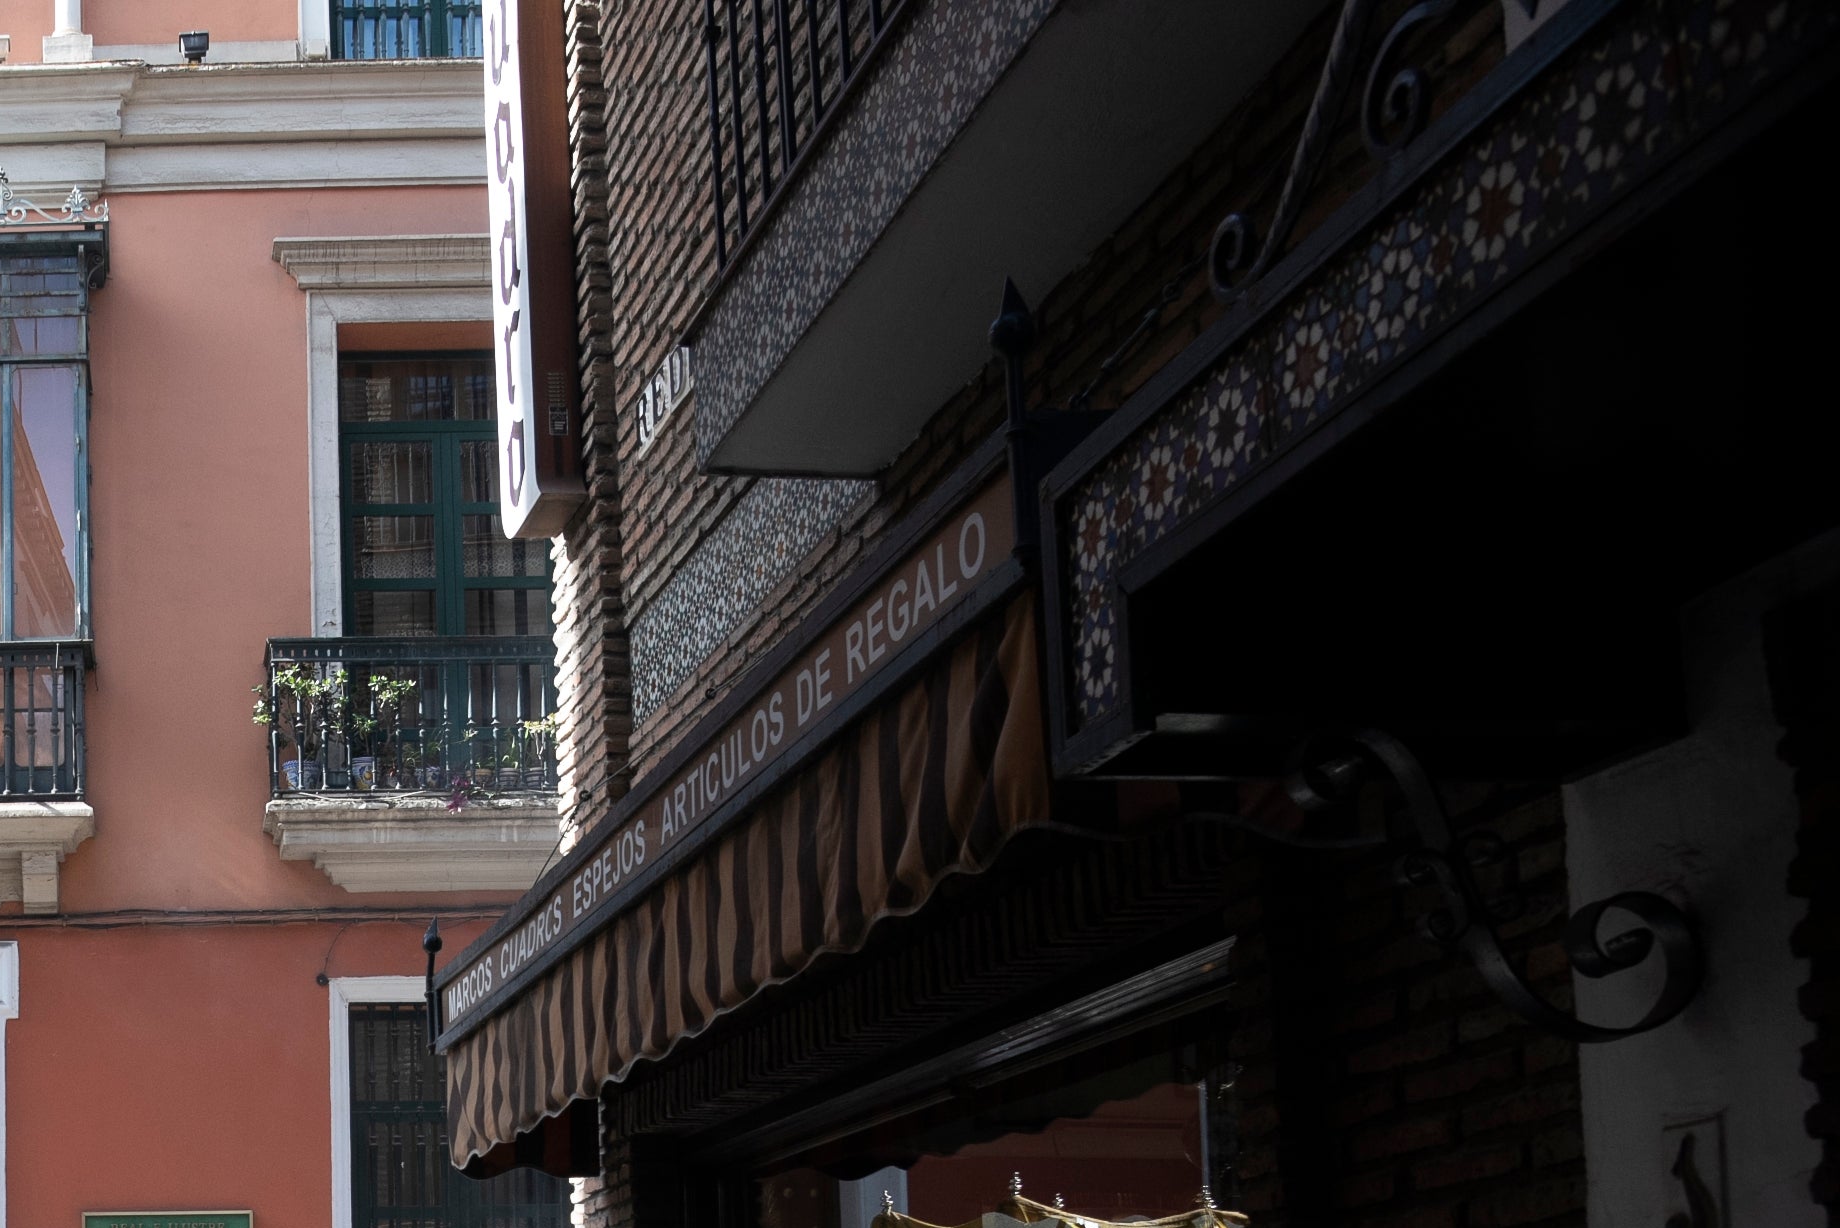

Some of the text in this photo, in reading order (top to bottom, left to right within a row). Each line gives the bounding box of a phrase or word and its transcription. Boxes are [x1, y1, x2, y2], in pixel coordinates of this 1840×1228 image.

[448, 960, 493, 1023] MARCOS
[572, 820, 646, 919] ESPEJOS
[661, 691, 784, 847] ARTICULOS
[797, 648, 833, 727] DE
[846, 512, 986, 685] REGALO
